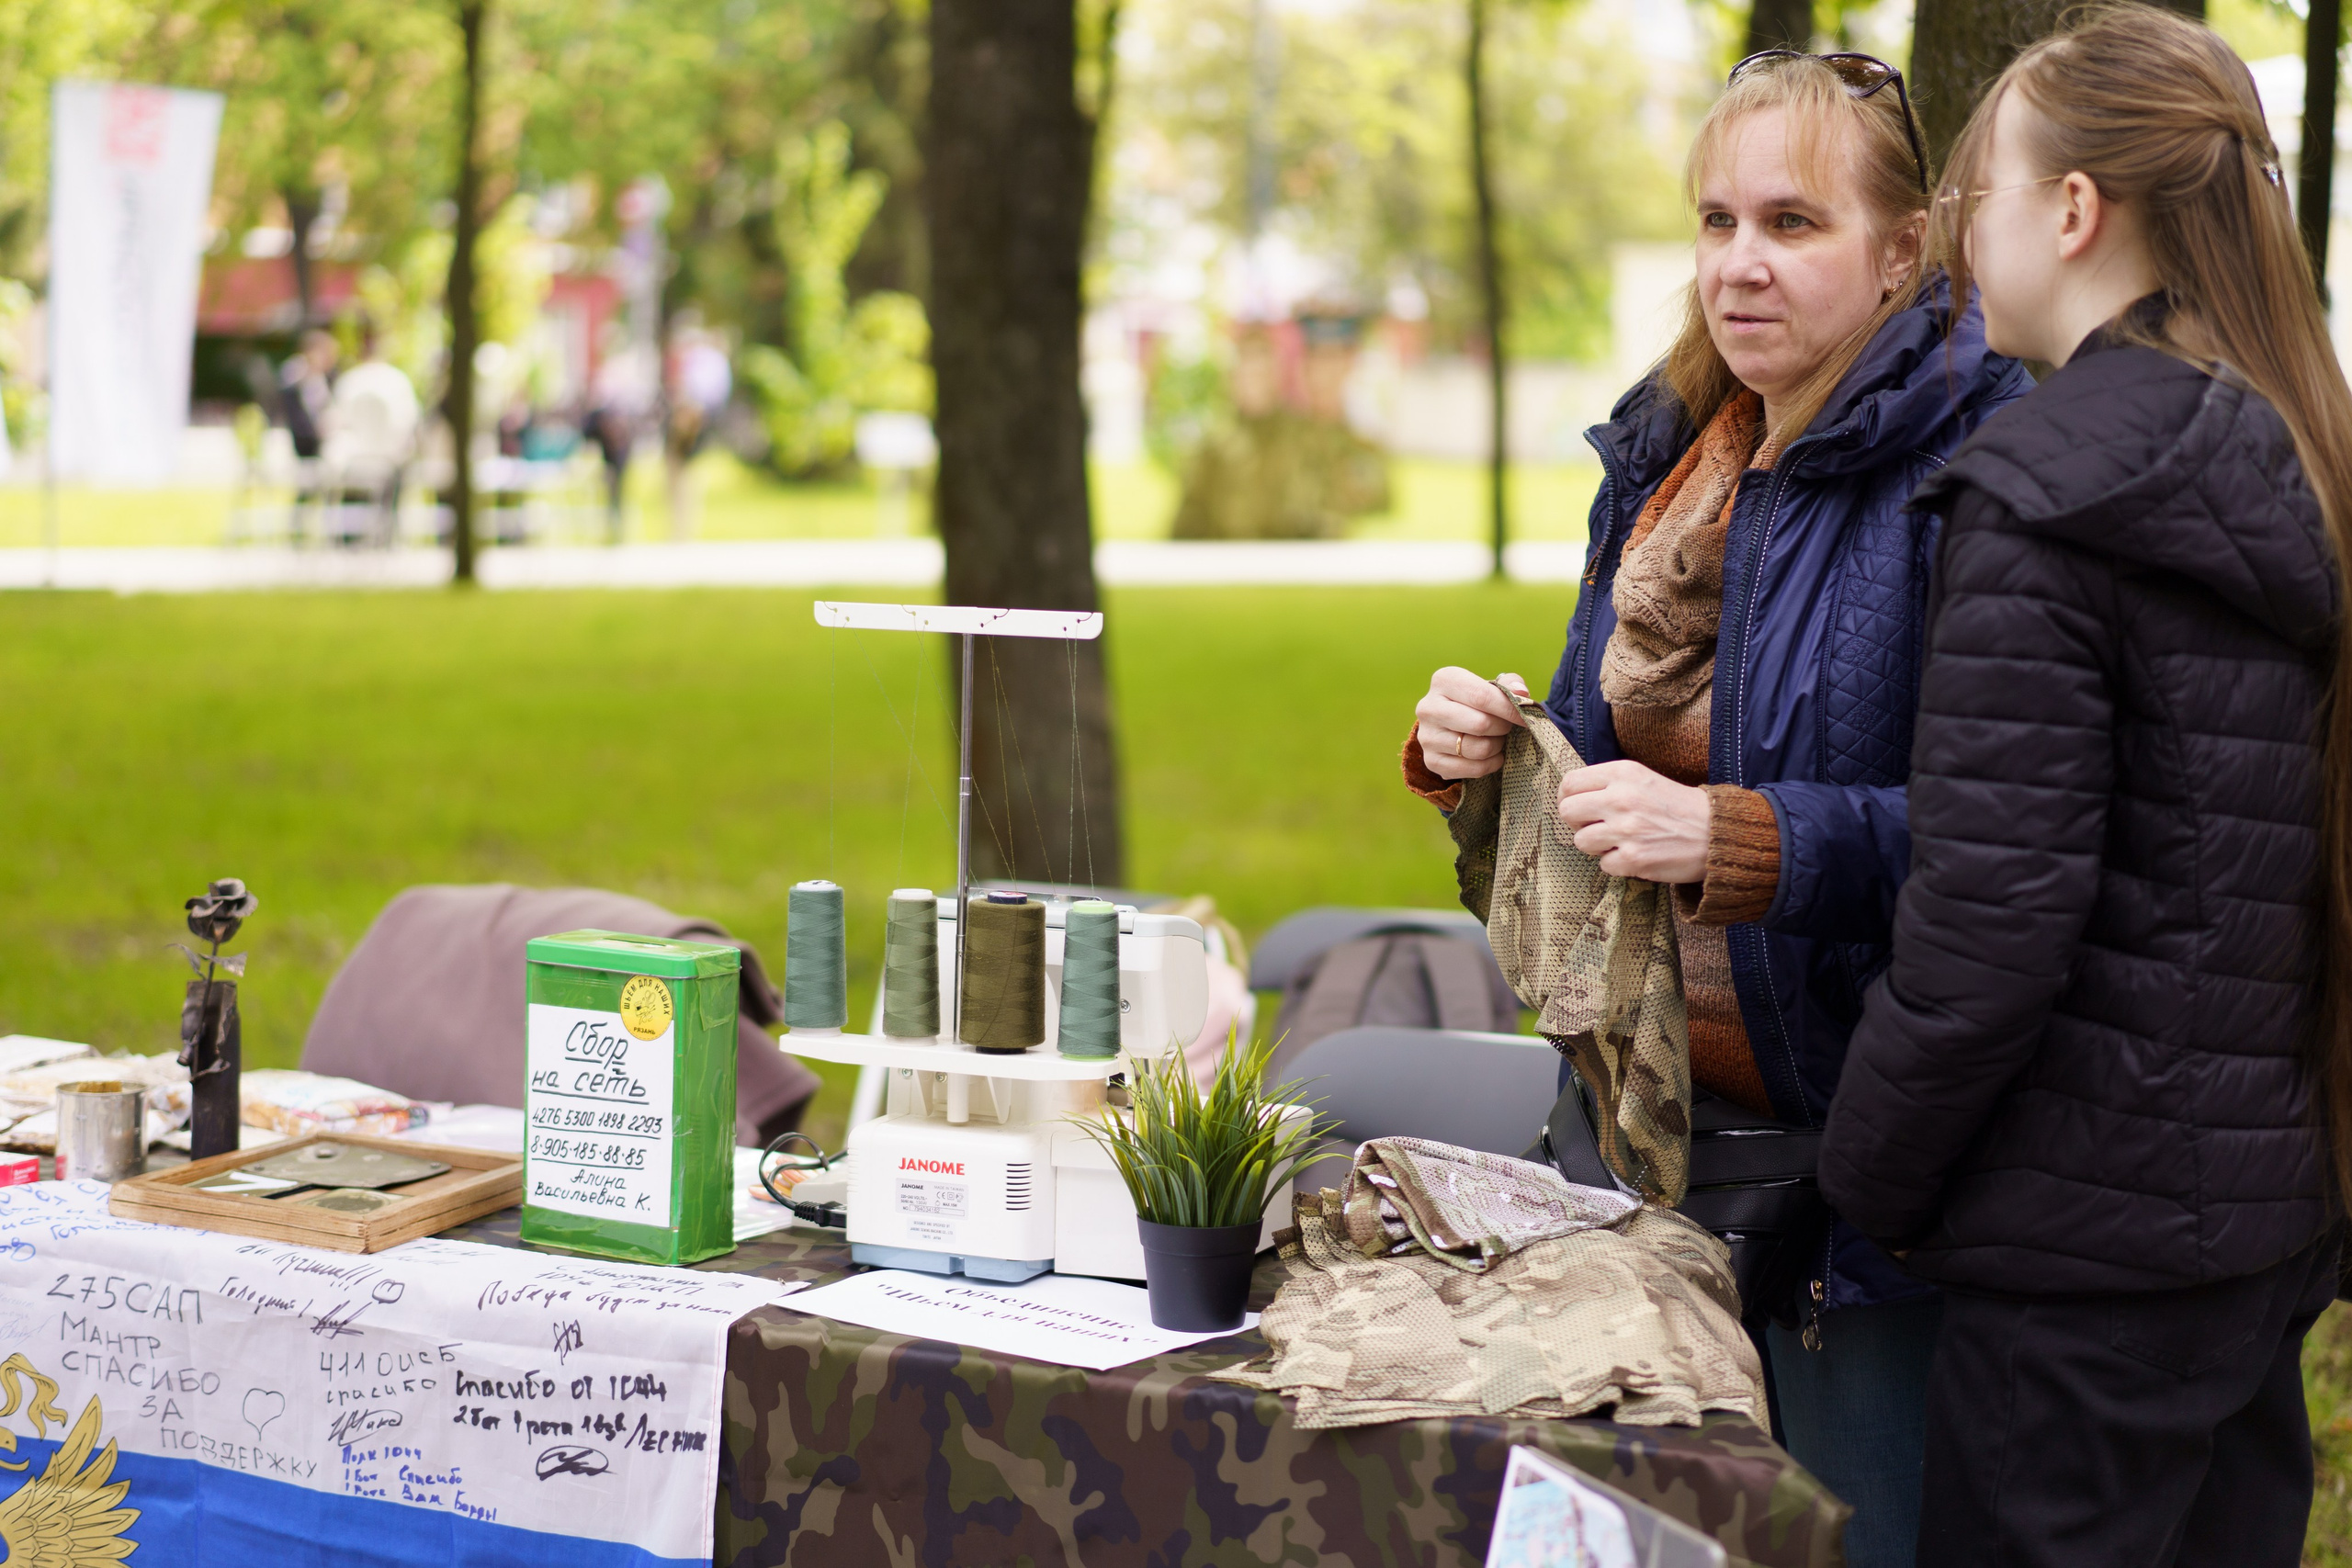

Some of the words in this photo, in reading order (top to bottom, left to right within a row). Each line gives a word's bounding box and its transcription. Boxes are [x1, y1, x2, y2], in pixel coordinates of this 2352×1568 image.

[565, 1021, 628, 1069] Сбор
[633, 1026, 656, 1035] РЯЗАНЬ
[531, 1070, 560, 1088] на
[574, 1067, 646, 1097] сеть
[532, 1107, 561, 1124] 4276
[564, 1110, 595, 1127] 5300
[598, 1111, 627, 1129] 1898
[628, 1115, 662, 1134] 2293
[571, 1168, 627, 1190] Алина
[899, 1157, 965, 1176] JANOME
[535, 1181, 627, 1208] Васильевна
[635, 1192, 650, 1211] К.
[944, 1287, 1136, 1329] Объединение
[62, 1351, 221, 1395] СПАСИБО
[139, 1395, 184, 1423] ЗА
[161, 1427, 318, 1479] ПОДДЕРЖКУ
